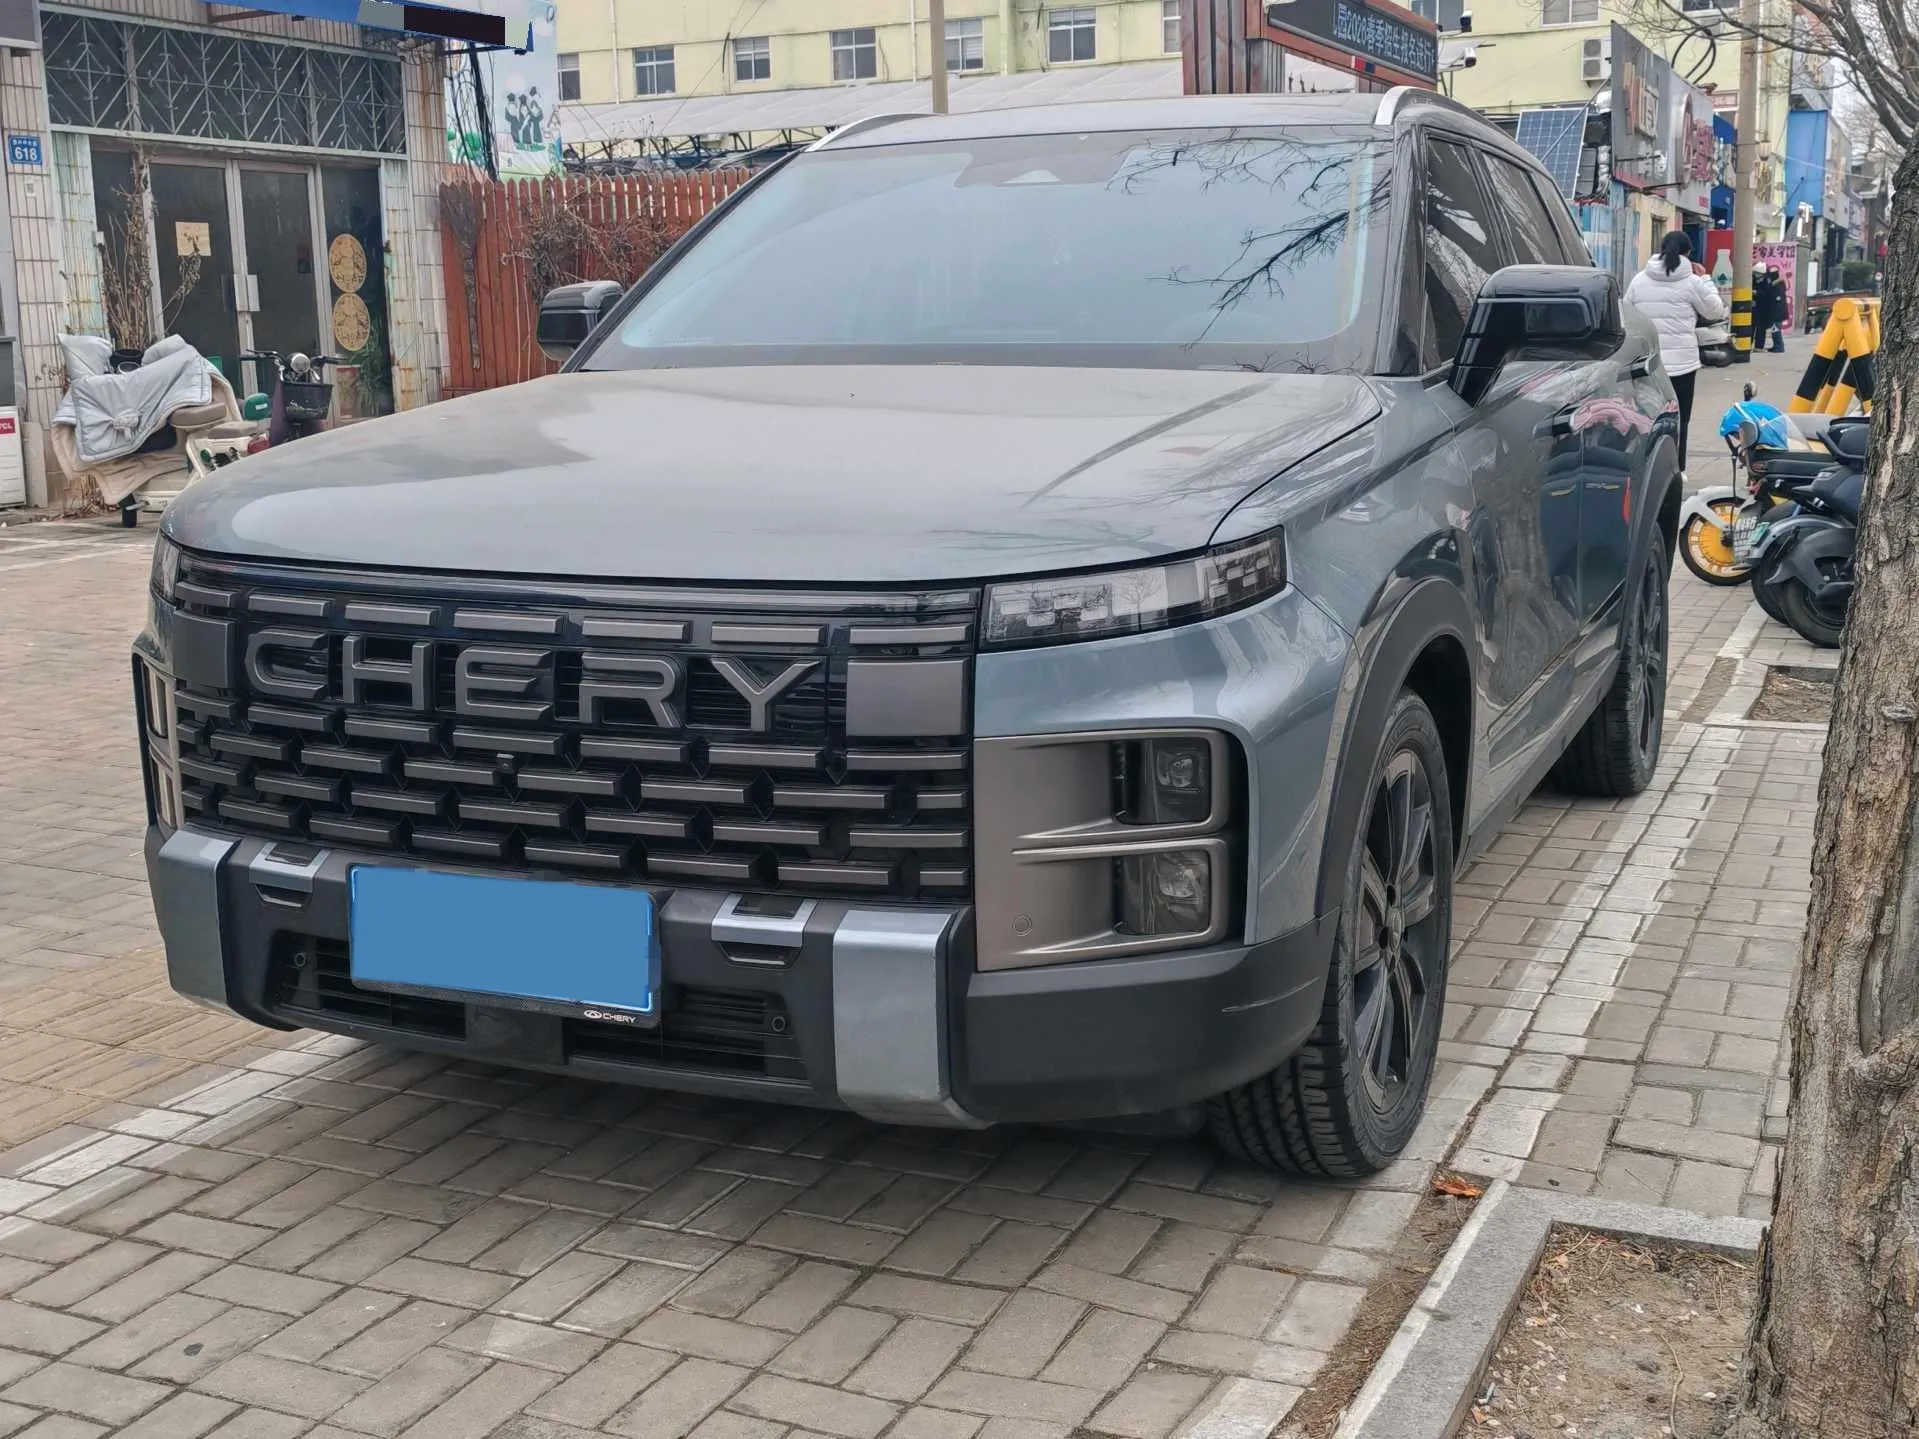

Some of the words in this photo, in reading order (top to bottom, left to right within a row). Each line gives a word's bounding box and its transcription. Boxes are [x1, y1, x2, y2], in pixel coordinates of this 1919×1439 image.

[15, 146, 37, 161] 618
[245, 626, 821, 733] CHERY
[603, 1012, 636, 1024] CHERY
